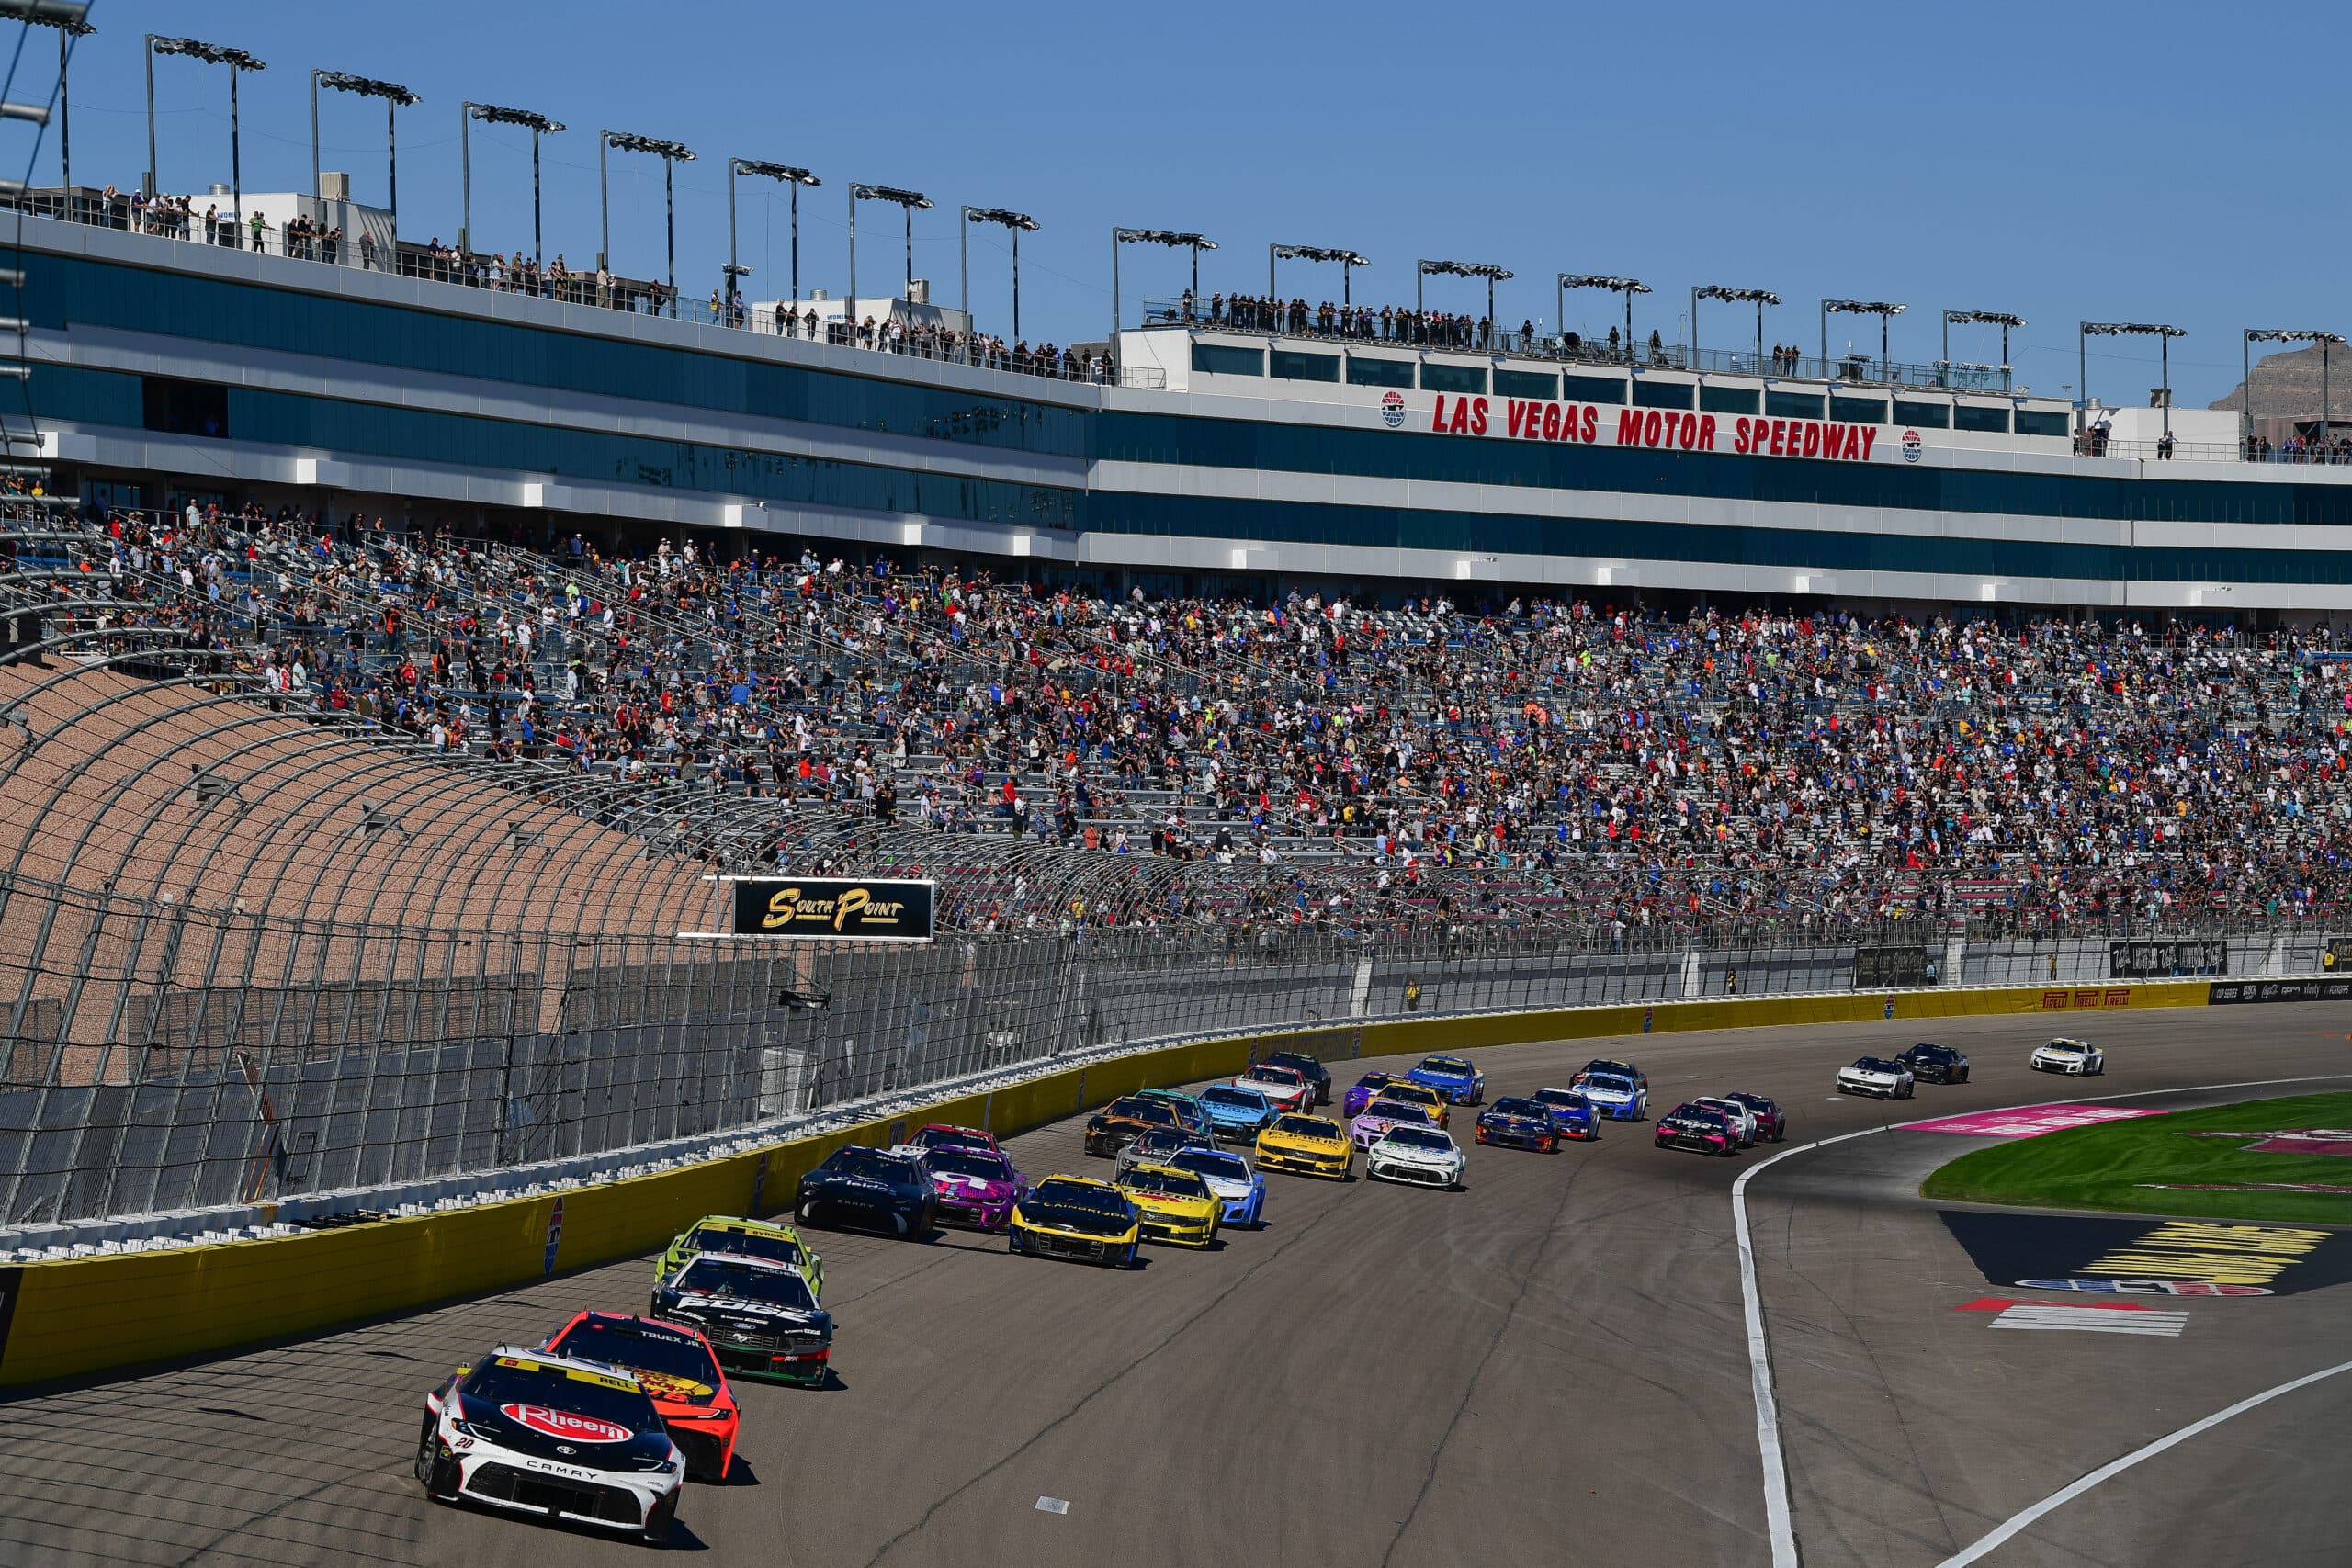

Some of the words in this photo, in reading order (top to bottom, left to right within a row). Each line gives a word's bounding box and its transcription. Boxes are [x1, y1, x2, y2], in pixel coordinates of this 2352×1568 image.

[1432, 395, 1489, 436] LAS
[1507, 399, 1599, 444] VEGAS
[1617, 409, 1716, 451] MOTOR
[1734, 417, 1877, 461] SPEEDWAY
[2042, 992, 2068, 1008] PIRELLI
[2074, 991, 2099, 1007] PIRELLI
[2103, 989, 2130, 1005] PIRELLI
[677, 1296, 814, 1324] EDGE
[640, 1330, 683, 1344] TRUEX
[685, 1339, 705, 1348] JR.
[599, 1377, 633, 1390] BELL
[517, 1404, 625, 1441] Rheem
[455, 1437, 475, 1449] 20
[526, 1460, 599, 1480] CAMRY
